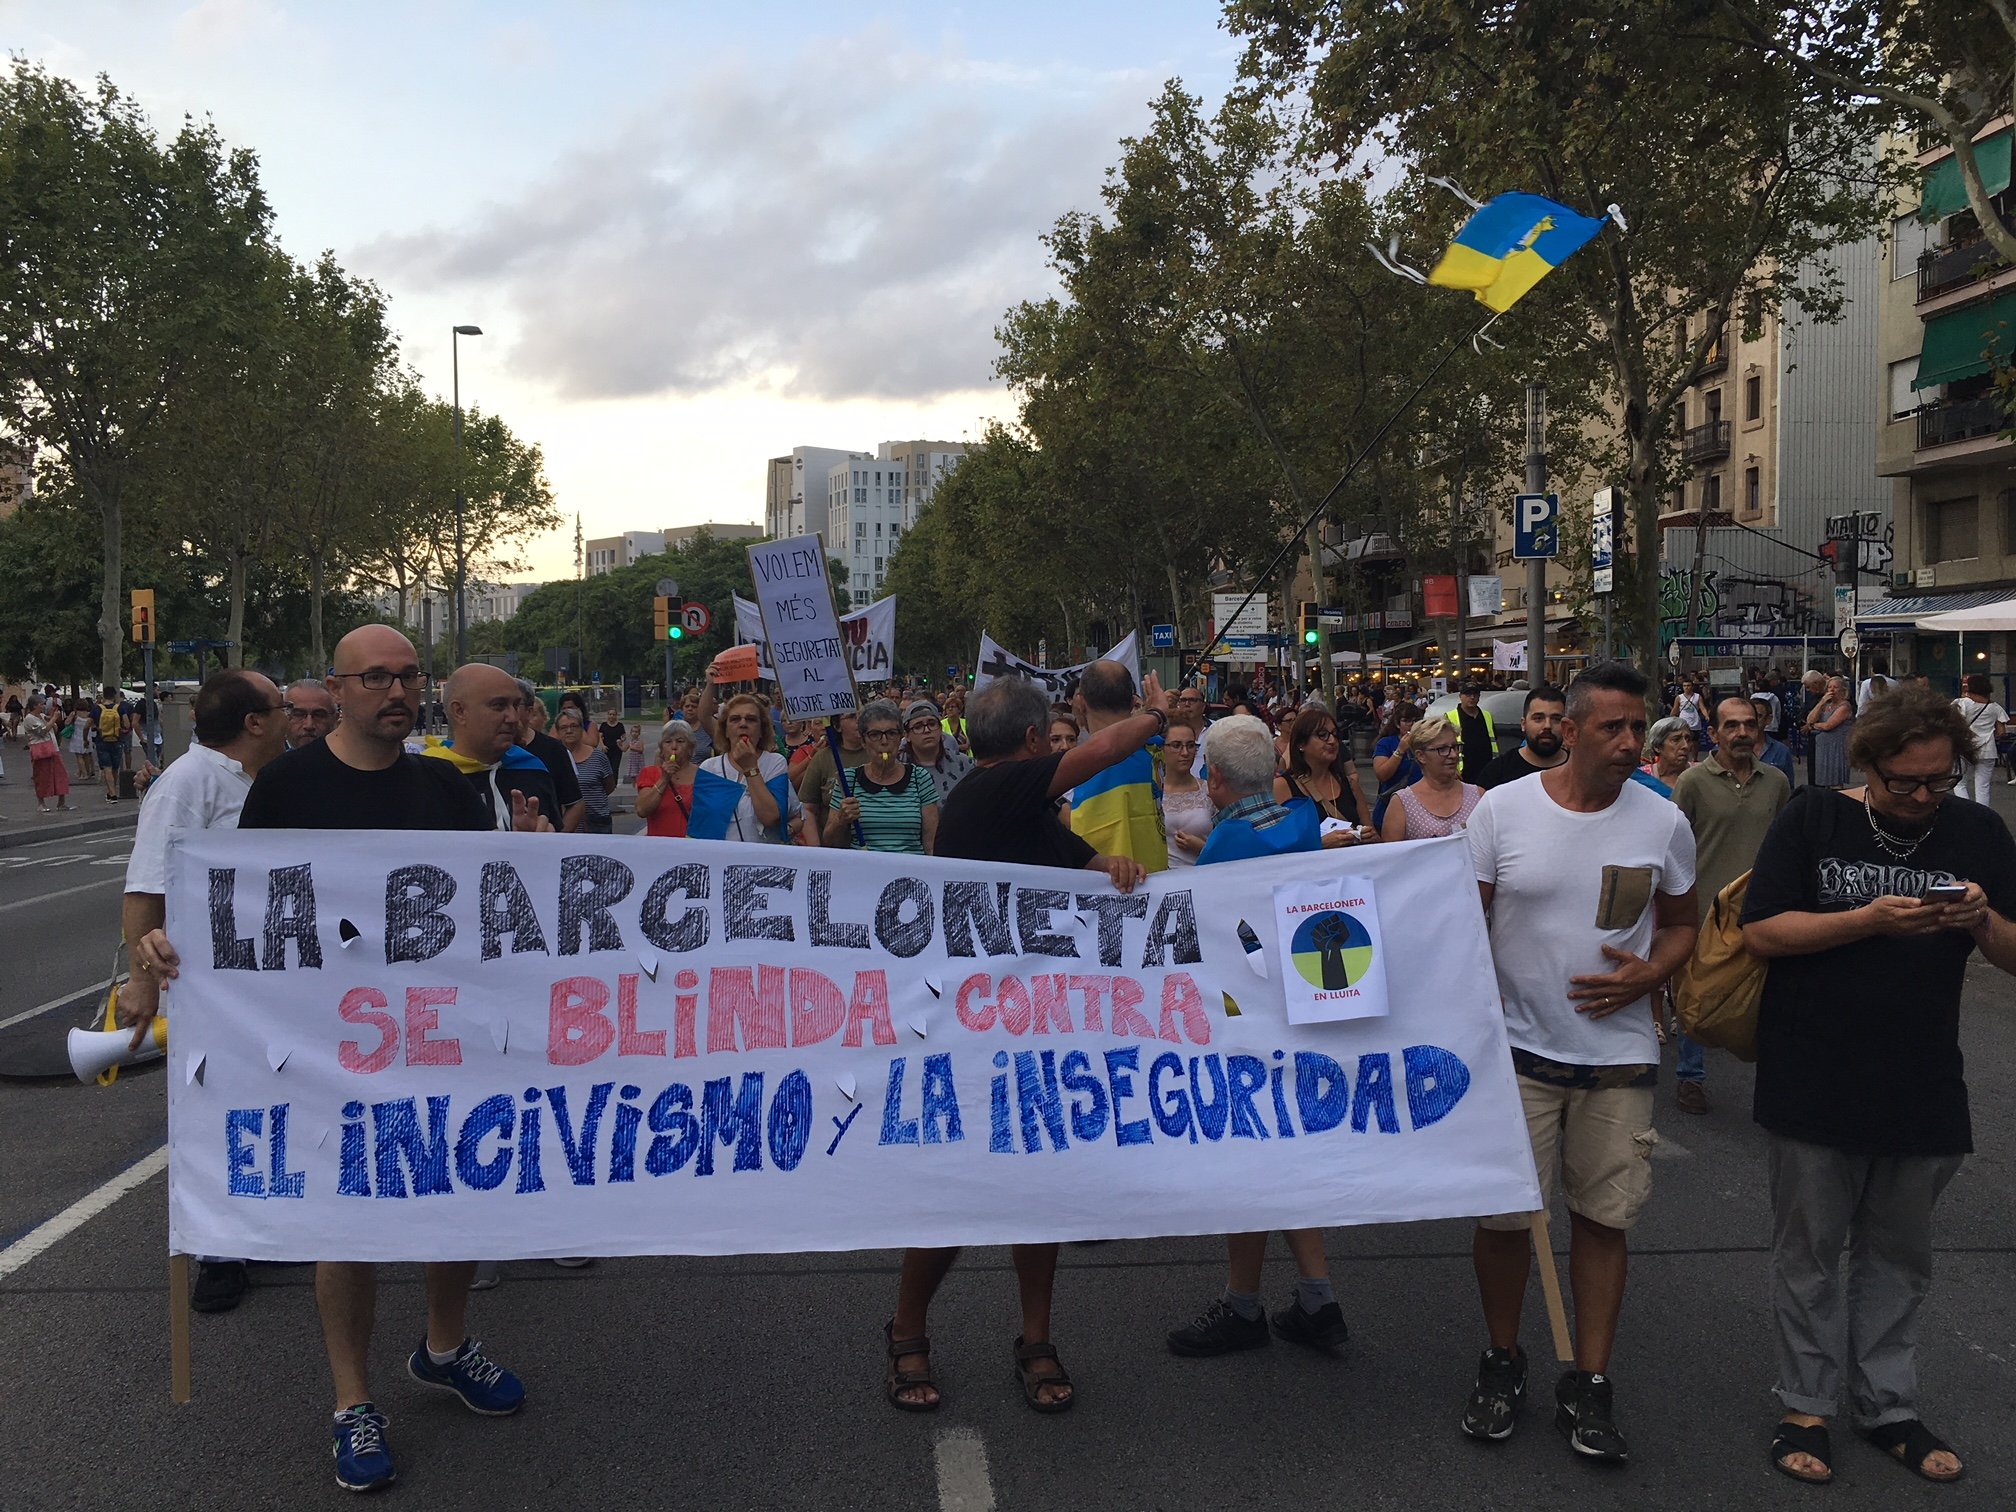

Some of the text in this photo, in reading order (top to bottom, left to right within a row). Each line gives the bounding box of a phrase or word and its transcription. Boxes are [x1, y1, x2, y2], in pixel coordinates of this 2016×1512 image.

[1523, 499, 1550, 533] P
[755, 549, 821, 583] VOLEM
[776, 593, 817, 622] MÉS
[1154, 632, 1172, 640] TAXI
[774, 638, 842, 664] SEGURETAT
[803, 668, 824, 682] AL
[785, 693, 825, 715] NOSTRE
[208, 854, 1203, 971] LA BARCELONETA
[1286, 898, 1366, 914] LA BARCELONETA
[1314, 989, 1361, 1001] EN LLUITA
[338, 986, 462, 1074] SE
[955, 972, 1211, 1045] CONTRA
[226, 1103, 305, 1200] EL
[879, 1053, 965, 1147] LA
